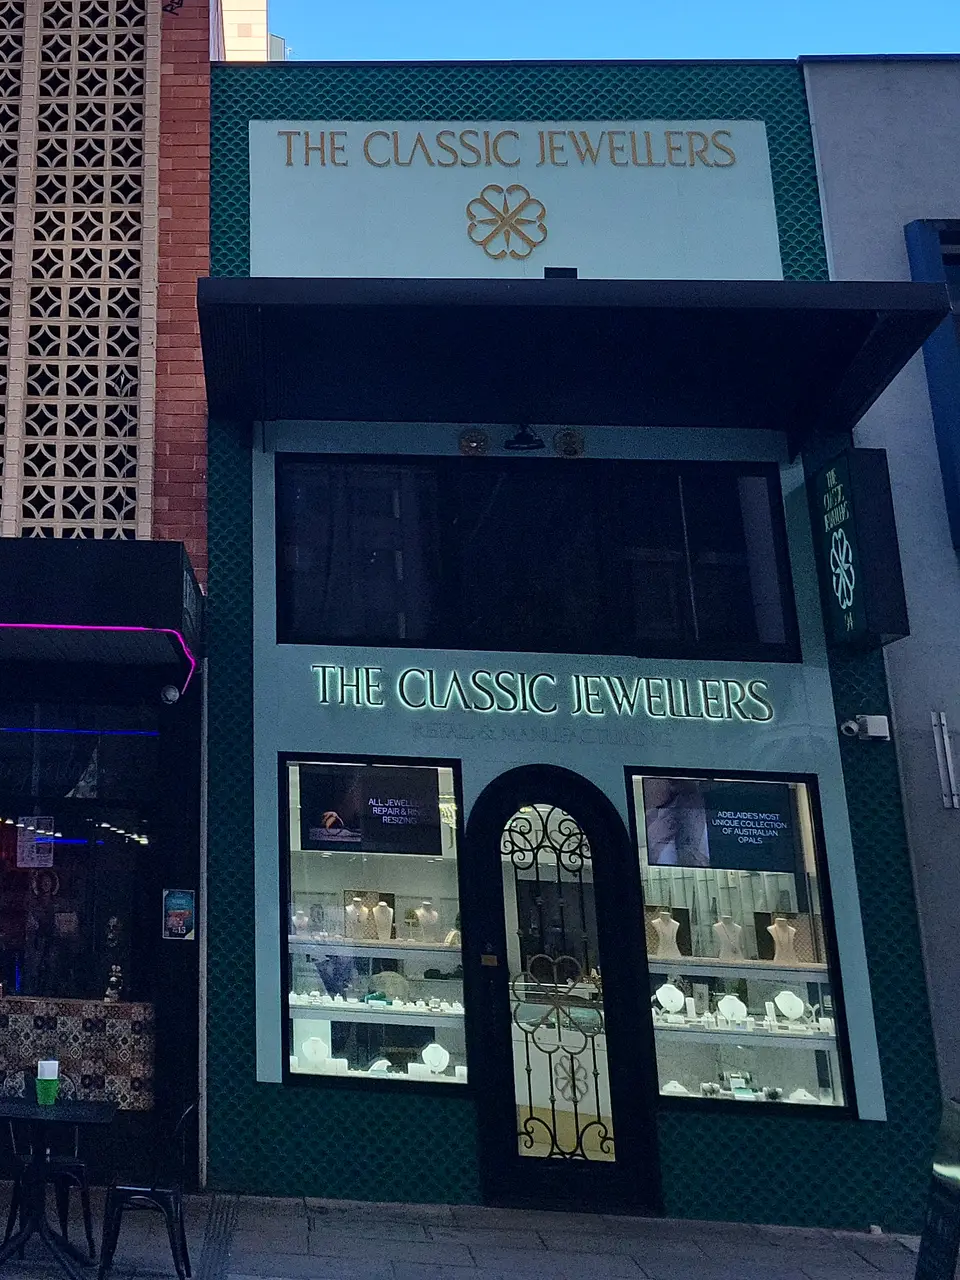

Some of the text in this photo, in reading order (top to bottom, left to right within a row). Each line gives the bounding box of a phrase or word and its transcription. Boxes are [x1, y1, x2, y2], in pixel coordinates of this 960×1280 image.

[277, 129, 737, 168] THE CLASSIC JEWELLERS
[311, 664, 776, 723] THE CLASSIC JEWELLERS
[368, 798, 384, 807] ALL
[372, 807, 400, 815] REPAIR
[717, 810, 781, 821] ADELAIDE'S MOST
[711, 819, 788, 829] UNIQUE COLLECTION
[721, 827, 779, 837] OF AUSTRALIAN
[737, 836, 763, 844] OPALS
